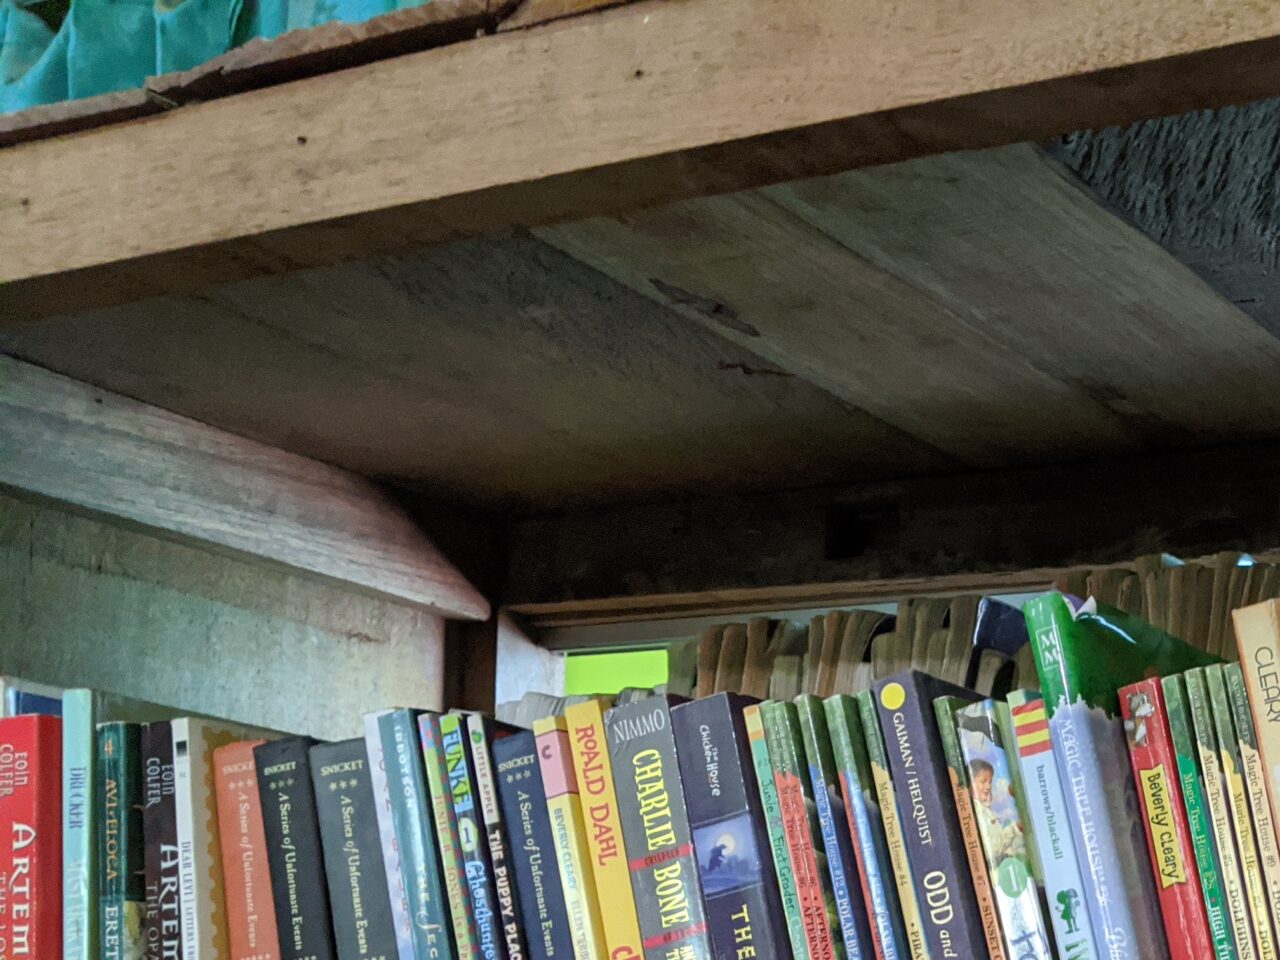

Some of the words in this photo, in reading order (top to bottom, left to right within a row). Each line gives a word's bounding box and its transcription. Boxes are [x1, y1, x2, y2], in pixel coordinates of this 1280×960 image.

[574, 723, 607, 795] ROALD
[612, 708, 667, 745] NIMMO
[632, 748, 677, 851] CHARLIE
[589, 802, 619, 867] DAHL
[495, 866, 514, 917] PUPPY
[653, 861, 689, 929] BONE
[922, 871, 953, 926] ODD
[939, 929, 956, 957] and
[730, 903, 756, 960] THE
